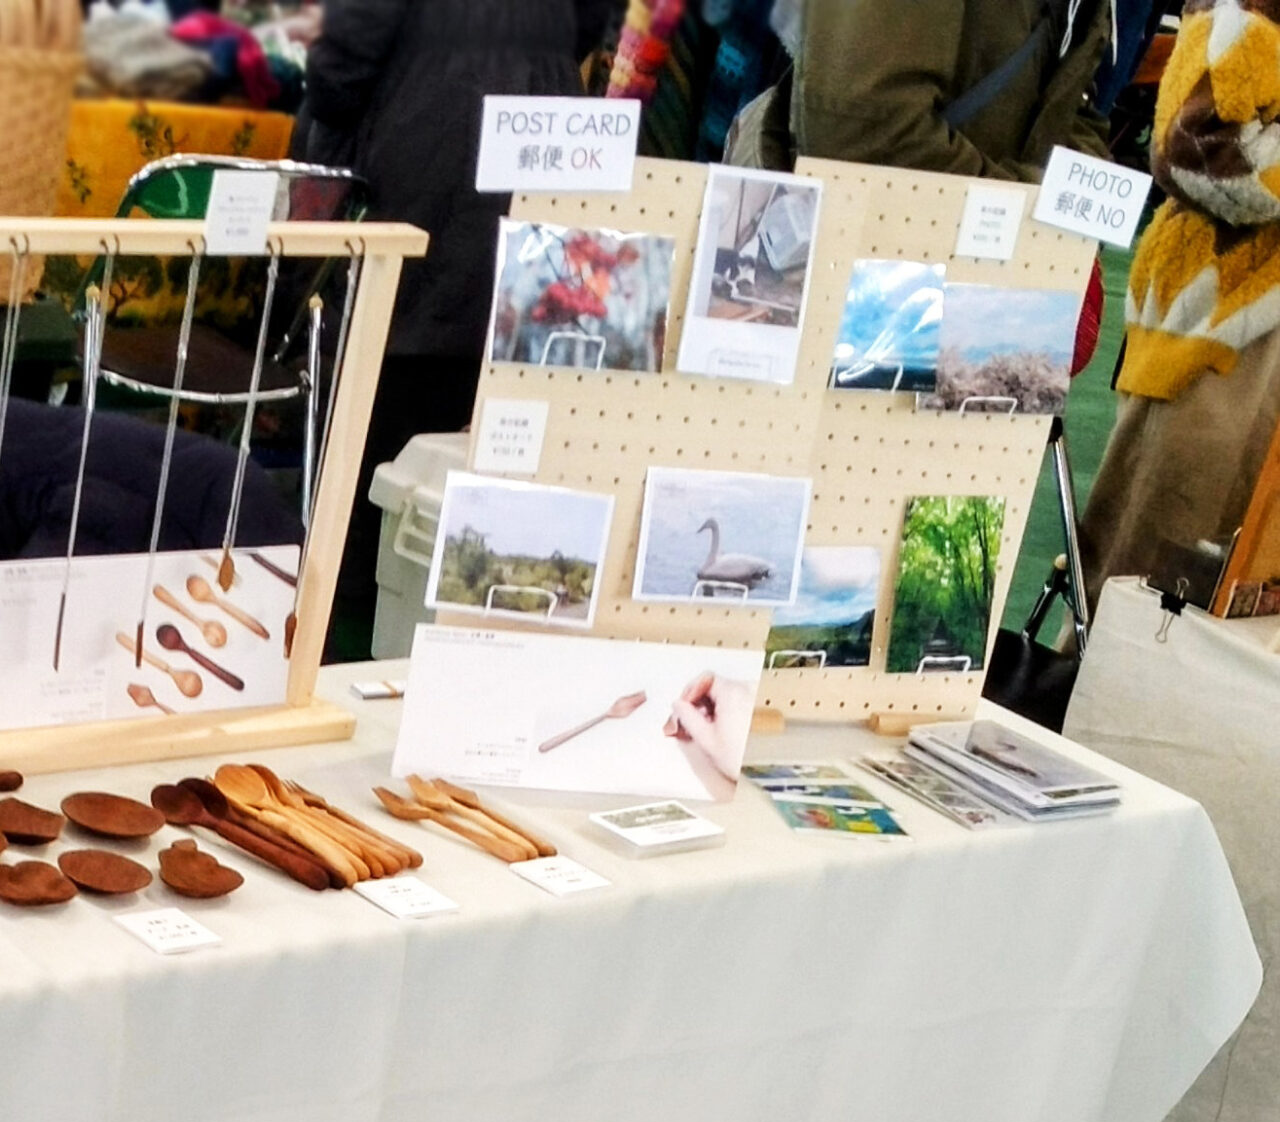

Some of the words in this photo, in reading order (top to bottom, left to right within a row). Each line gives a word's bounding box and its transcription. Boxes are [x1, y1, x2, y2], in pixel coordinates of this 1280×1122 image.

[497, 111, 557, 135] POST
[566, 113, 632, 137] CARD
[518, 144, 564, 171] 郵便
[571, 148, 603, 170] OK
[1068, 162, 1132, 199] PHOTO
[1055, 191, 1094, 222] 郵便
[1097, 205, 1126, 229] NO
